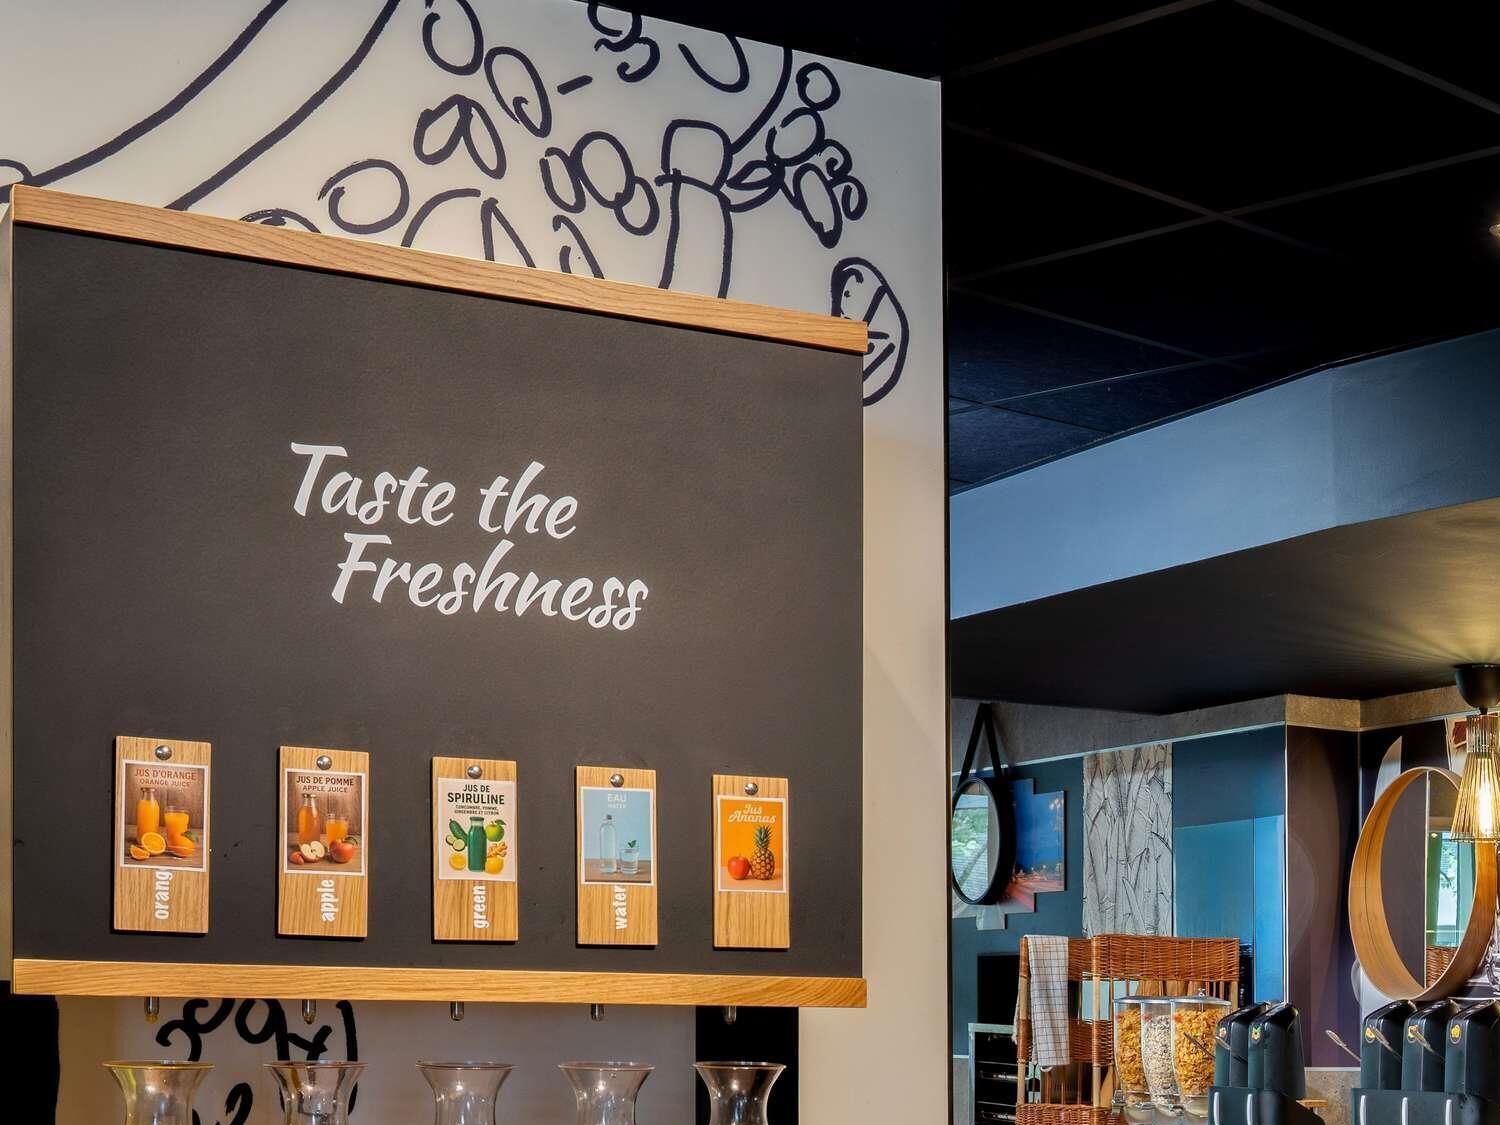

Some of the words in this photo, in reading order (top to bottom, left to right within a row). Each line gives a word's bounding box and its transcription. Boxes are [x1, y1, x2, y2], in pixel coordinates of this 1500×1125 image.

[291, 442, 455, 526] Taste
[479, 461, 578, 539] the
[331, 532, 649, 631] Freshness
[135, 768, 150, 777] JUS
[152, 770, 197, 780] D'ORANGE
[296, 775, 311, 784] JUS
[325, 778, 354, 786] POMME
[463, 784, 478, 792] JUS
[447, 792, 505, 805] SPIRULINE
[607, 793, 627, 802] EAU
[743, 803, 762, 814] Jus
[728, 810, 776, 824] Ananas
[154, 870, 173, 920] orang
[316, 879, 339, 922] apple
[472, 885, 490, 928] green
[613, 885, 628, 930] water
